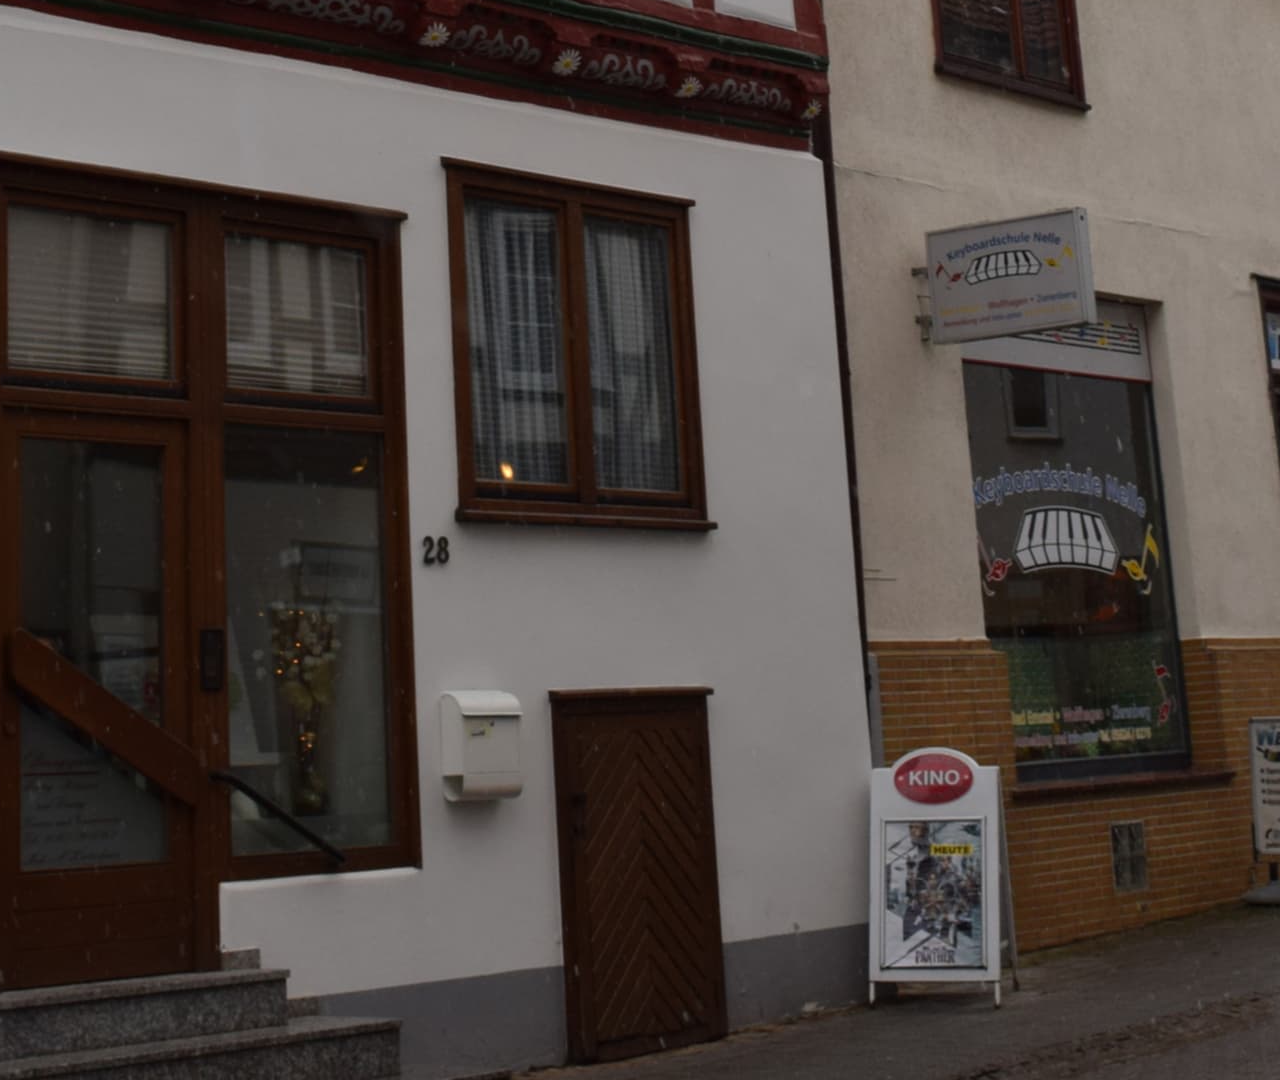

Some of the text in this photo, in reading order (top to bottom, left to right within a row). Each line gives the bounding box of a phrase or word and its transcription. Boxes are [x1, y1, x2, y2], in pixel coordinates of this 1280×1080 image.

[946, 232, 1062, 262] Keyboardschule Nelle
[973, 462, 1147, 518] Keyboardschule Nelle
[423, 535, 450, 565] 28
[908, 770, 961, 787] KINO
[933, 845, 971, 855] HEUTE
